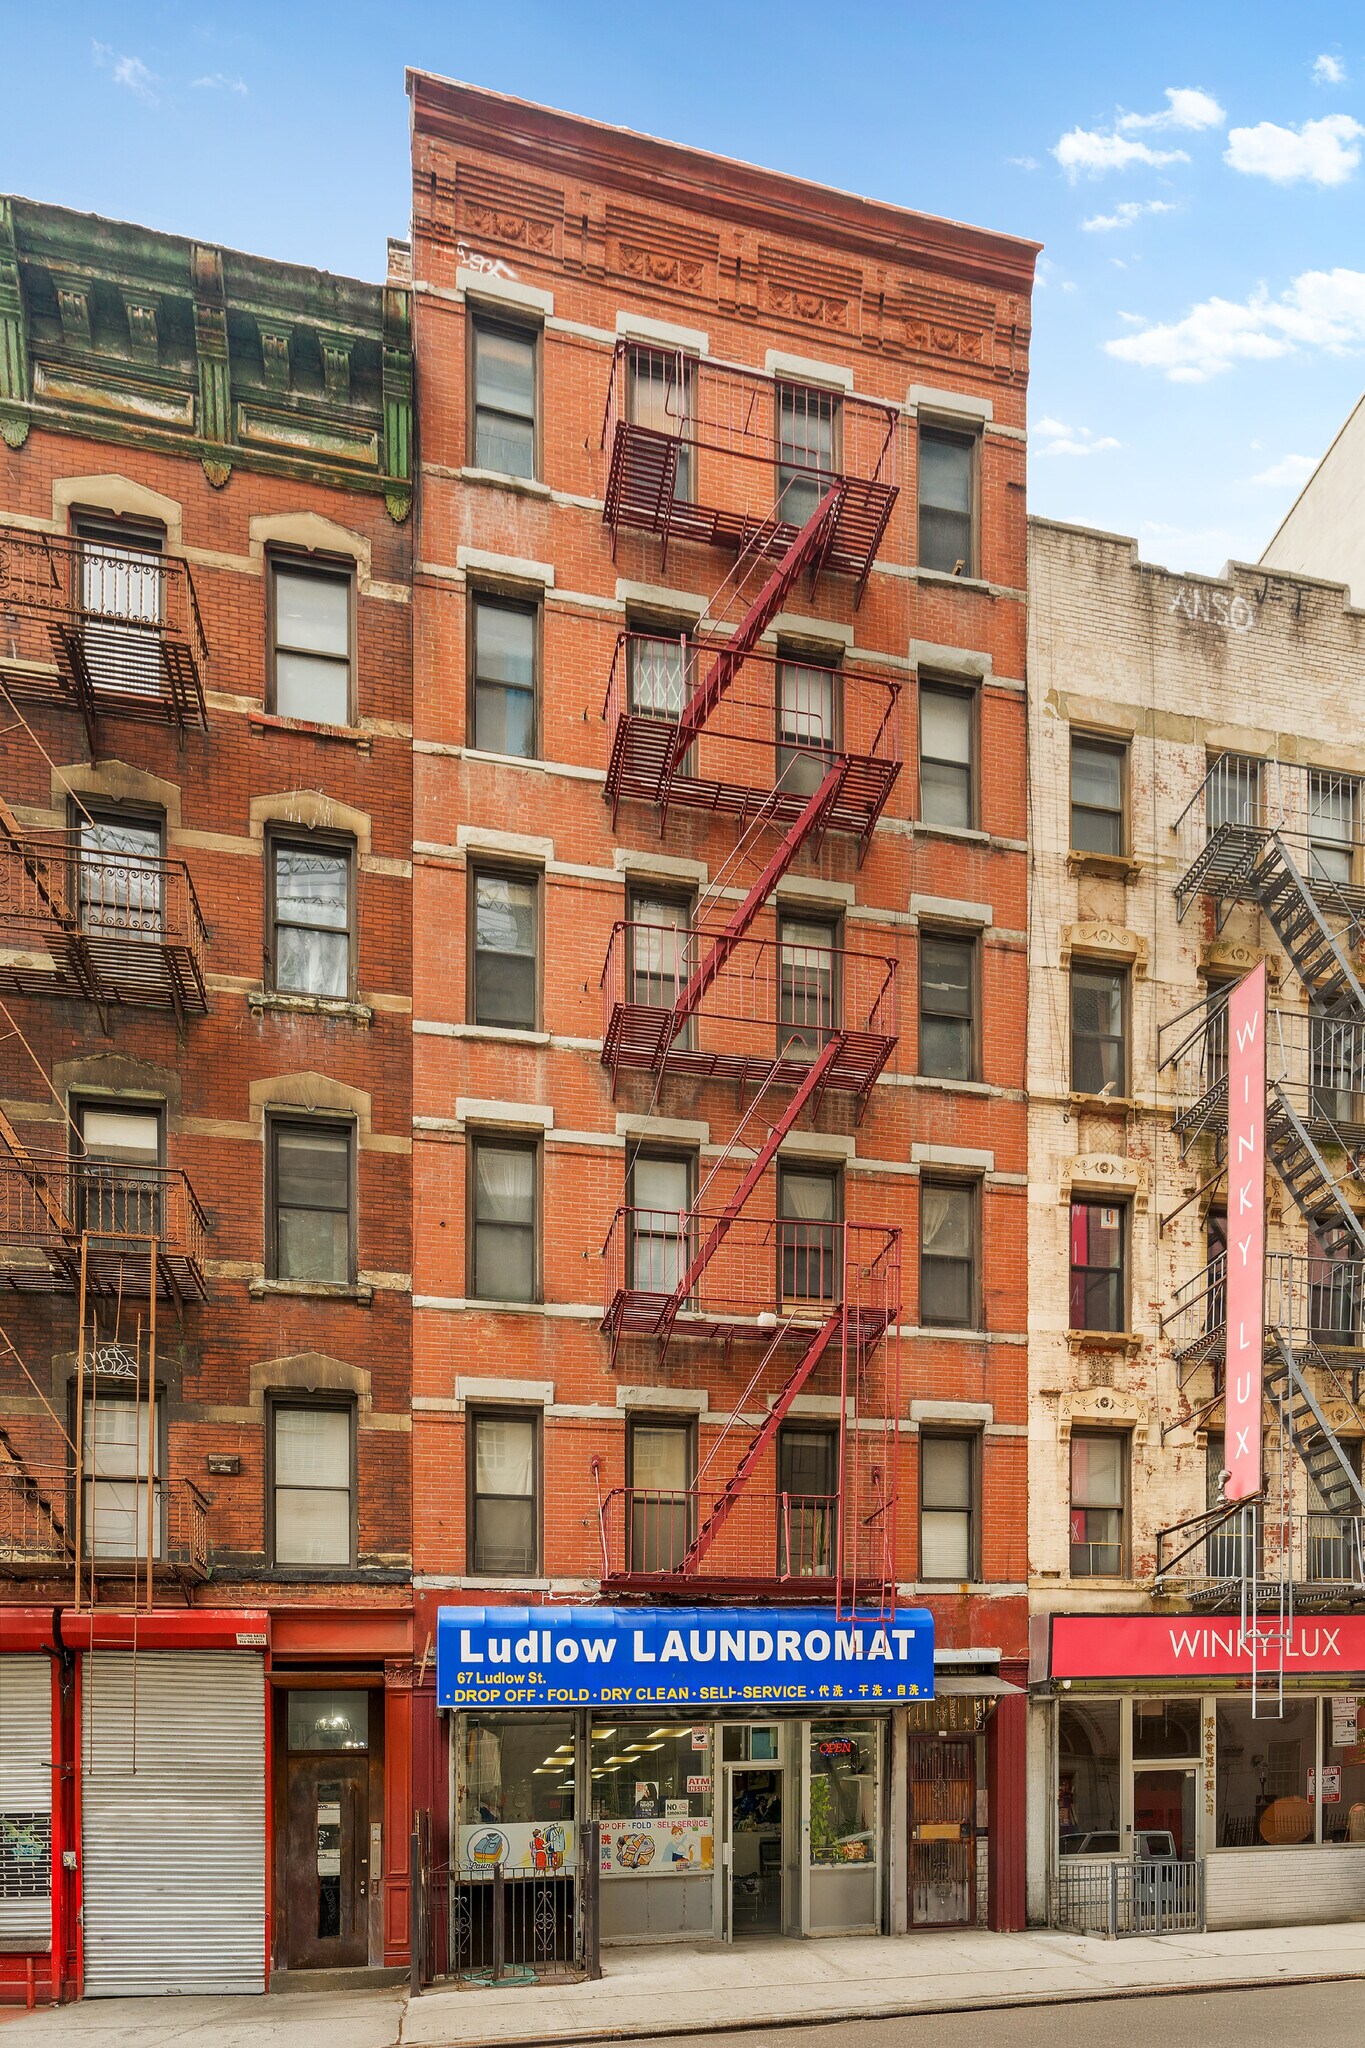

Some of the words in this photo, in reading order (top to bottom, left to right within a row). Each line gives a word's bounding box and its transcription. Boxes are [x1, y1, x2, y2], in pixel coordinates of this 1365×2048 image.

[1236, 1010, 1258, 1267] WINKY
[1235, 1321, 1250, 1460] LUX
[460, 1629, 616, 1663] Ludlow
[633, 1629, 916, 1662] LAUNDROMAT
[1169, 1629, 1274, 1658] WINKY
[1286, 1628, 1341, 1657] LUX
[457, 1672, 474, 1684] 67
[476, 1672, 525, 1684] Ludlow
[528, 1672, 547, 1684] St.
[454, 1689, 500, 1702] DROP
[504, 1689, 536, 1702] OFF
[547, 1689, 589, 1701] FOLD
[601, 1688, 632, 1701] DRY
[635, 1687, 689, 1700] CLEAN
[818, 1684, 844, 1698] 代洗
[858, 1684, 883, 1697] 干洗
[819, 1742, 852, 1754] OPEN
[666, 1803, 678, 1811] NO
[612, 1822, 626, 1830] OFF
[632, 1821, 652, 1829] FOLD
[677, 1819, 708, 1829] SERVICE
